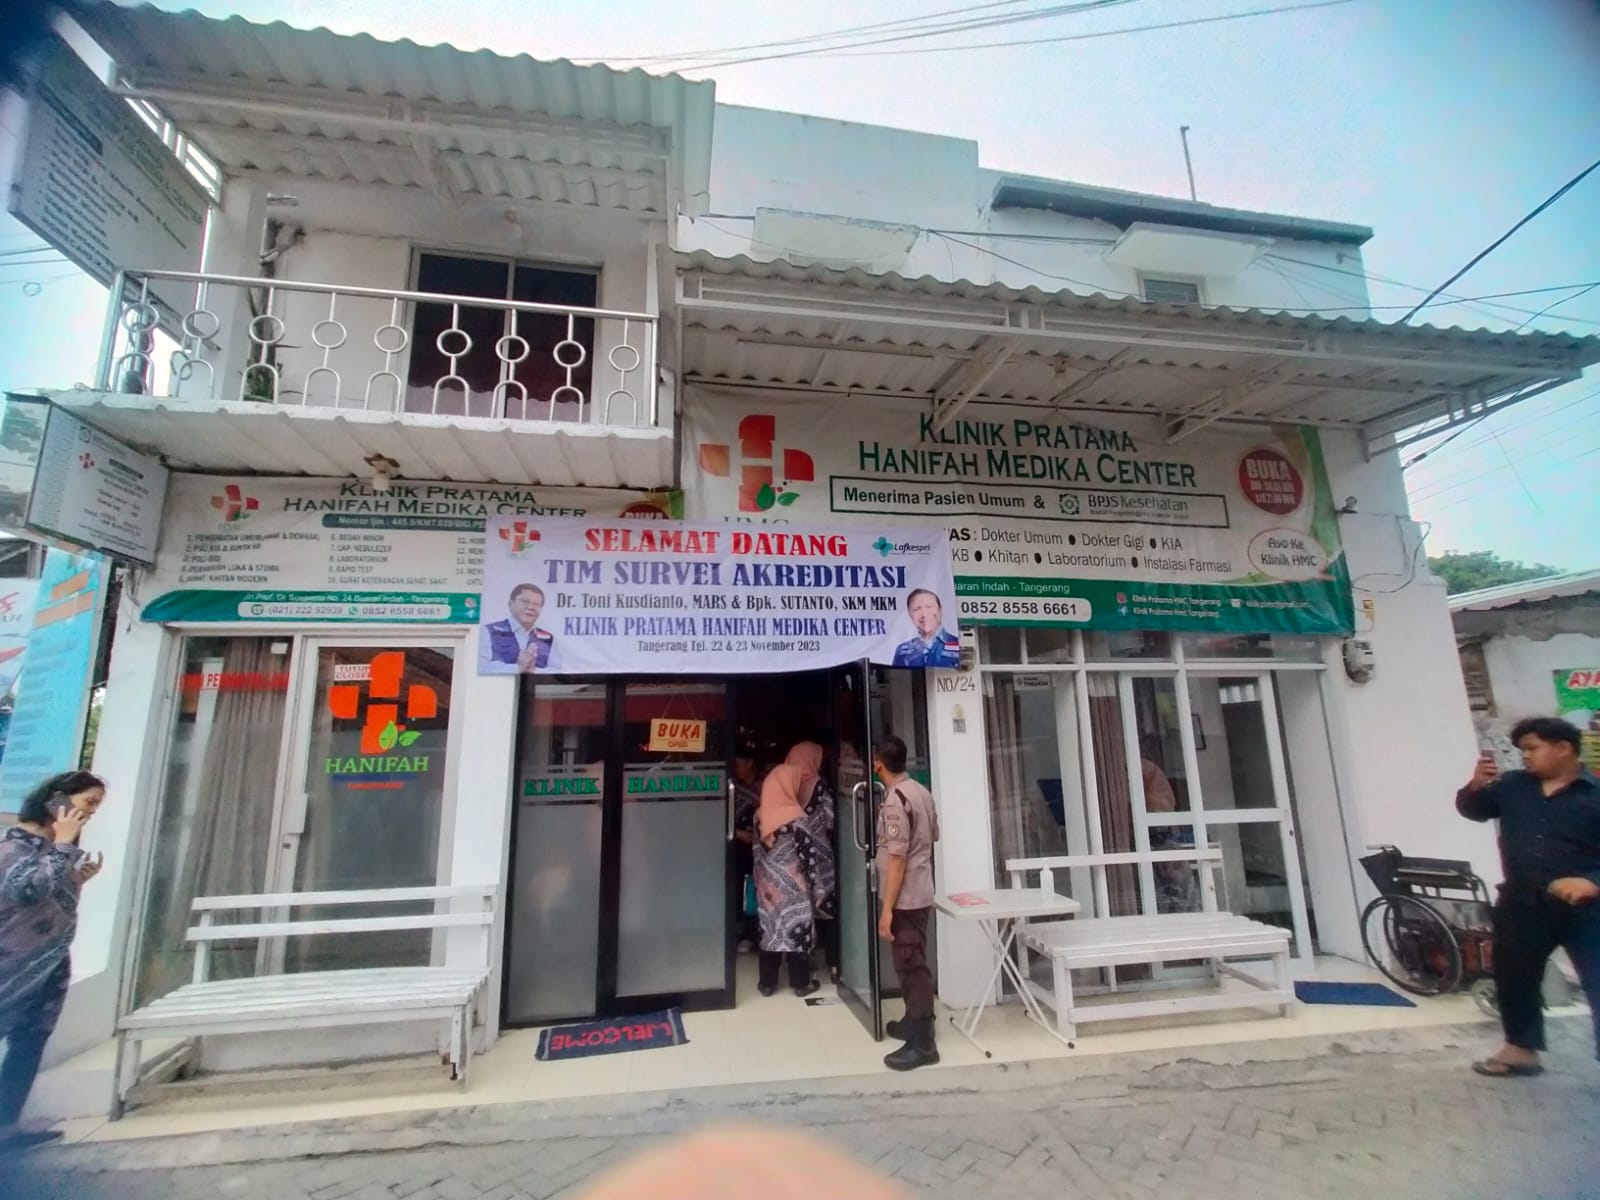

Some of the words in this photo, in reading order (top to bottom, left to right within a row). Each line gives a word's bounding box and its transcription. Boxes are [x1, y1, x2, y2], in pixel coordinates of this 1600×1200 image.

[919, 411, 1005, 447] KLINIK
[1013, 418, 1139, 453] PRATAMA
[858, 440, 979, 476] HANIFAH
[987, 448, 1090, 482] MEDIKA
[1096, 453, 1197, 488] CENTER
[1245, 458, 1294, 481] BUKA
[426, 486, 537, 504] PRATAMA
[843, 486, 920, 505] Menerima
[924, 490, 976, 506] Pasien
[978, 492, 1025, 508] Umum
[1033, 494, 1046, 509] &
[283, 497, 390, 513] HANIFAH
[397, 499, 488, 517] MEDIKA
[584, 527, 721, 554] SELAMAT
[731, 530, 849, 558] DATANG
[944, 527, 971, 541] AS
[981, 527, 1022, 543] Dokter
[1024, 530, 1063, 545] Umum
[1082, 533, 1121, 548] Dokter
[1124, 534, 1145, 551] Gigi
[1161, 537, 1183, 550] KIA
[952, 549, 970, 562] KB
[988, 549, 1029, 566] Khitan
[1047, 551, 1127, 569] Laboratorium
[1143, 556, 1187, 571] Instalasi
[1189, 558, 1232, 573] Farmasi
[1260, 553, 1290, 566] Klinik
[1292, 554, 1318, 567] HMC
[544, 558, 602, 585] TIM
[614, 561, 722, 586] SURVEI
[732, 563, 907, 588] AKREDITASI
[954, 583, 980, 591] aran
[981, 581, 1010, 592] Indah
[1019, 583, 1070, 596] Tangerang
[295, 606, 312, 615] 222
[362, 606, 387, 615] 0852
[556, 592, 578, 610] Dr.
[582, 594, 611, 609] Toni
[615, 594, 688, 611] Kusdianto,
[692, 596, 727, 610] MARS
[732, 597, 741, 610] &
[746, 595, 777, 614] Bpk.
[780, 597, 838, 613] SUTANTO,
[842, 598, 866, 612] SKM
[869, 598, 897, 612] MKM
[960, 601, 998, 614] 0852
[1002, 602, 1039, 615] 8558
[1041, 602, 1077, 616] 6661
[564, 618, 620, 636] KLINIK
[624, 618, 697, 637] PRATAMA
[703, 617, 768, 636] HANIFAH
[772, 617, 829, 636] MEDIKA
[833, 617, 886, 635] CENTER
[637, 640, 689, 655] Tangerang
[711, 640, 724, 652] 22
[726, 640, 734, 652] &
[736, 640, 749, 652] 23
[750, 640, 795, 653] November
[797, 640, 821, 652] 2023
[657, 723, 700, 739] BUKA
[325, 756, 429, 774] HANIFAH
[523, 777, 601, 796] KLINIK
[627, 774, 720, 794] HANIFAH
